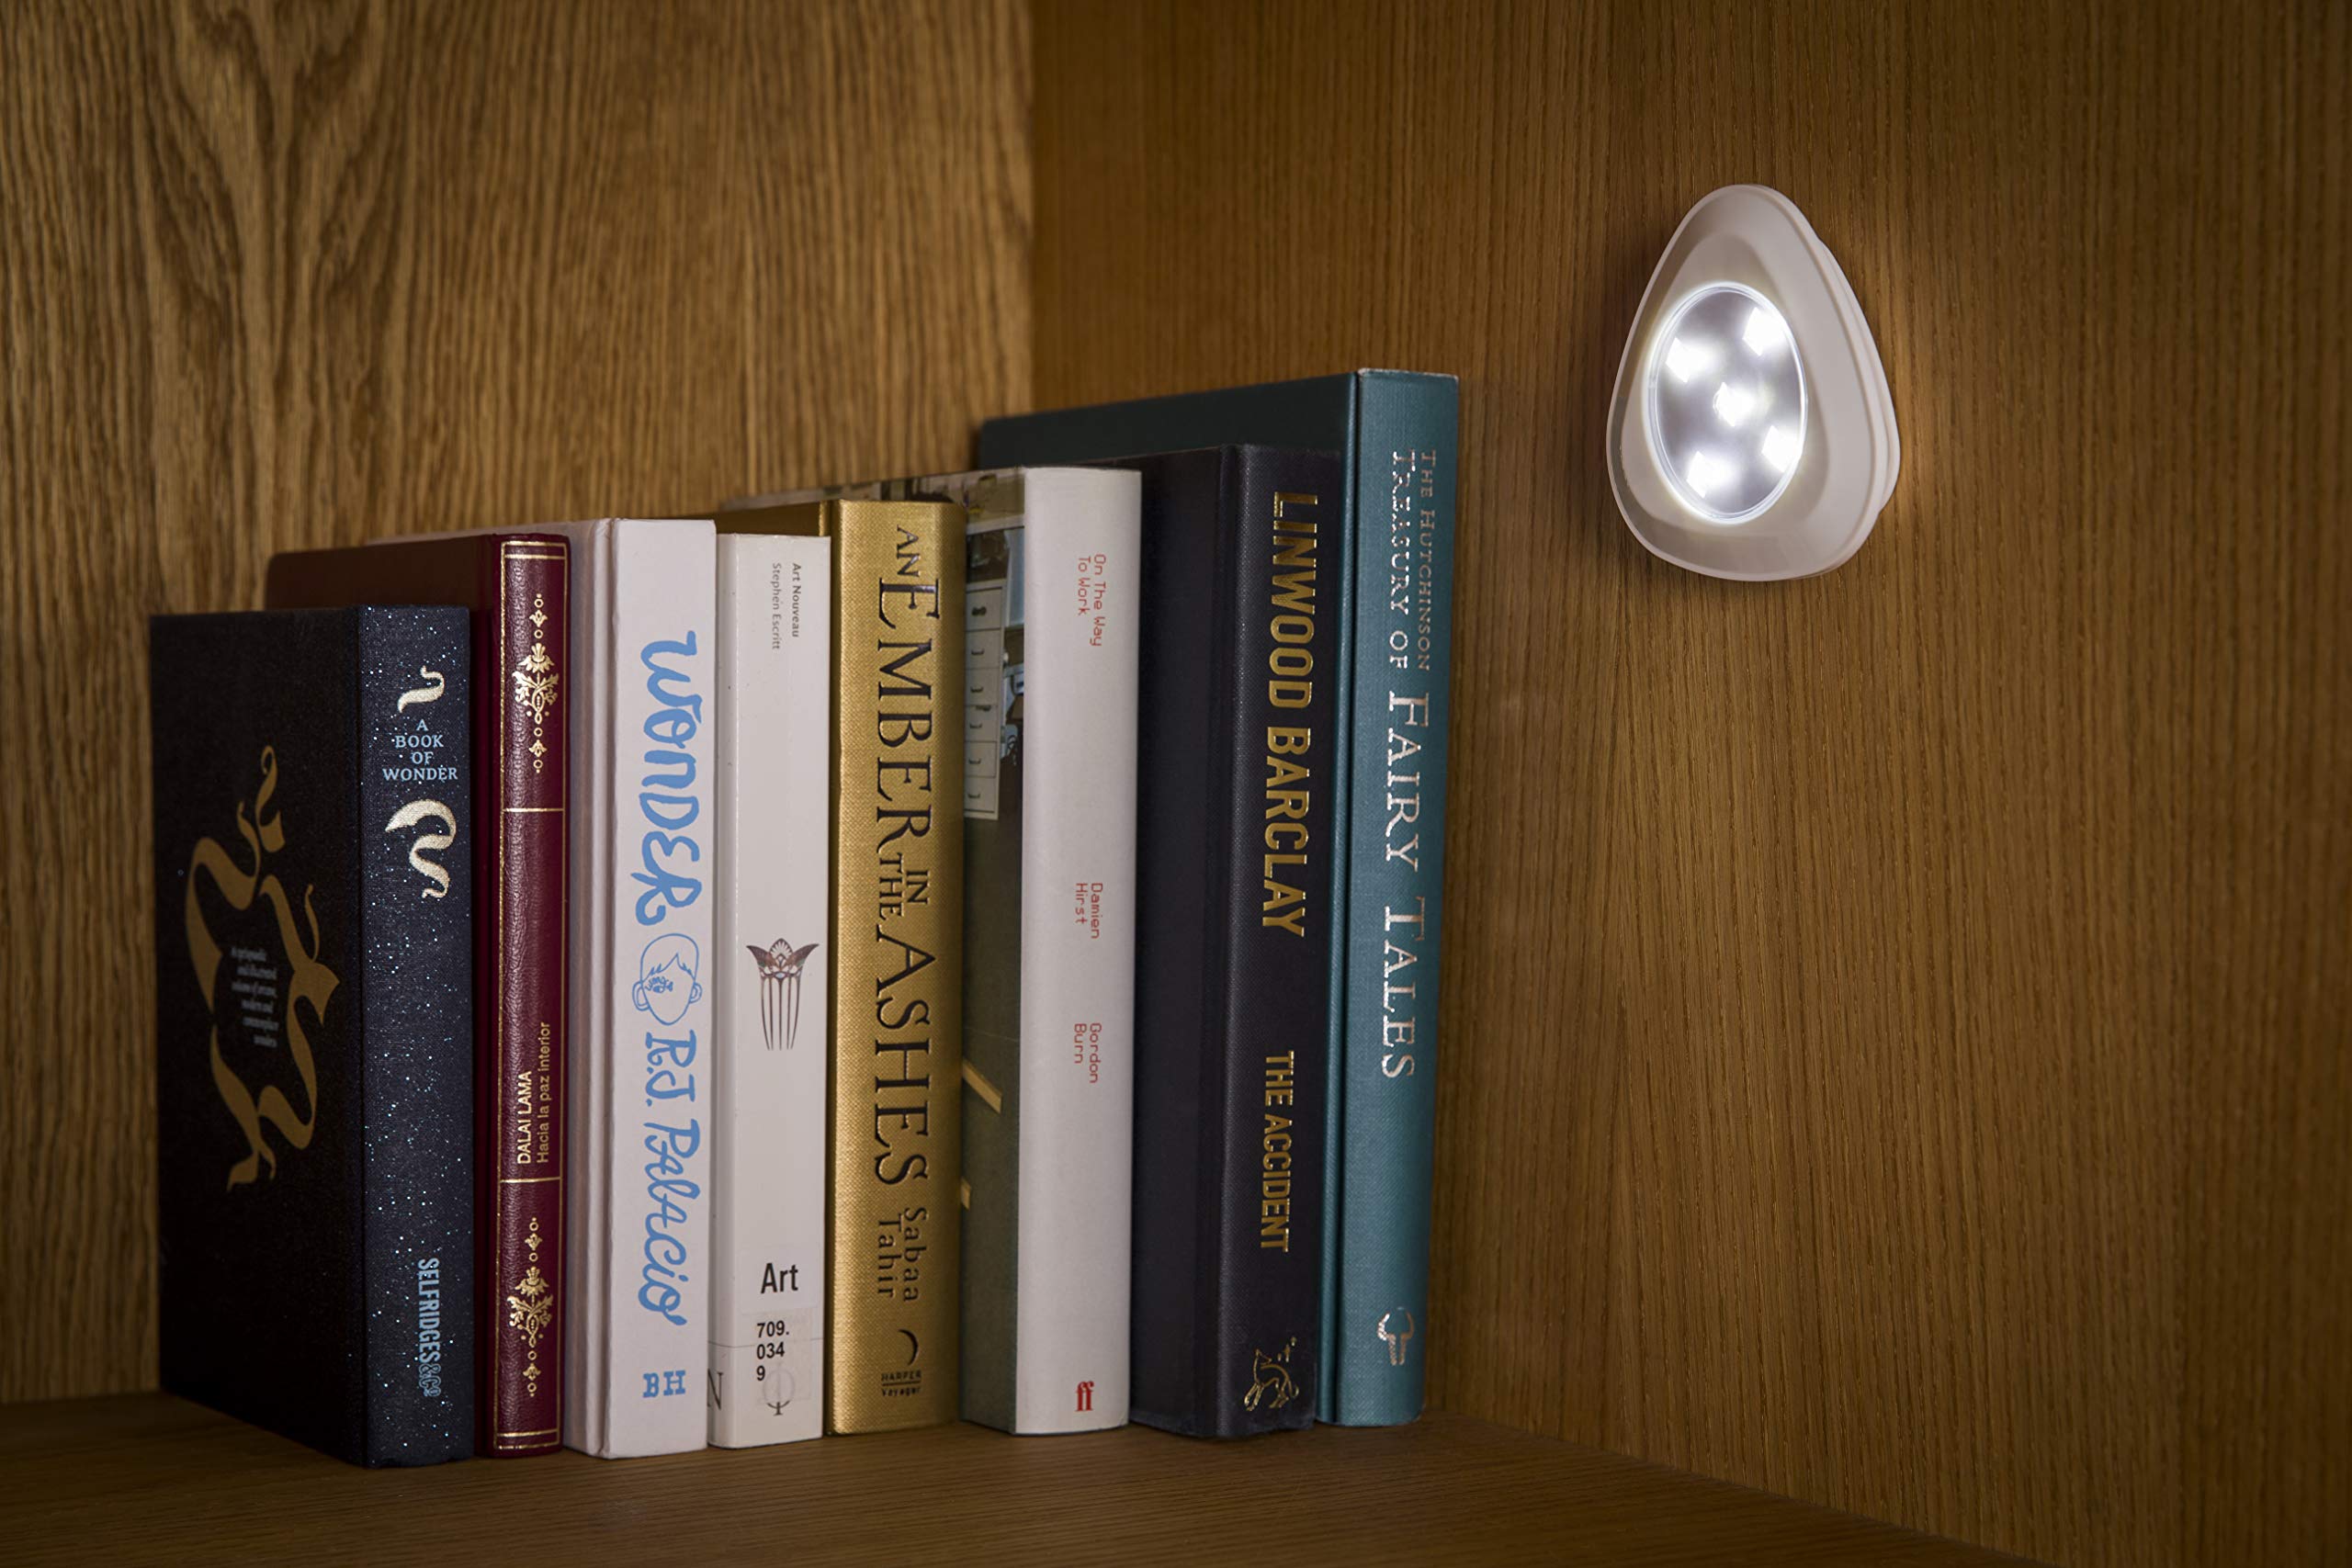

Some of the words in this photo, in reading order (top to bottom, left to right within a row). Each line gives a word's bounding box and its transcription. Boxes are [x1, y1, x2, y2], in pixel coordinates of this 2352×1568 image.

[1420, 449, 1436, 499] THE
[897, 524, 921, 578] AN
[1390, 449, 1416, 615] TREASURY
[770, 562, 782, 610] Stephen
[792, 562, 802, 581] Art
[1078, 556, 1091, 572] To
[1093, 554, 1106, 576] On
[792, 585, 802, 637] Nouveau
[1078, 577, 1091, 616] Work
[1093, 581, 1106, 611] The
[1268, 491, 1318, 709] LINWOOD
[1418, 509, 1435, 671] HUTCHINSON
[772, 614, 783, 649] Escritt
[1090, 616, 1106, 647] Way
[1389, 630, 1408, 670] OF
[416, 719, 429, 731] A
[876, 577, 940, 853] EMBER
[395, 735, 444, 748] BOOK
[411, 751, 434, 765] OF
[382, 767, 458, 782] WONDER
[1385, 690, 1430, 873] FAIRY
[1262, 727, 1312, 938] BARCLAY
[879, 852, 904, 921] THE
[906, 870, 929, 905] IN
[1075, 883, 1088, 924] Hirst
[1091, 883, 1103, 939] Damien
[1381, 896, 1425, 1078] TALES
[537, 1021, 551, 1071] interior
[875, 923, 935, 1185] ASHES
[1074, 1022, 1087, 1064] Burn
[1089, 1022, 1102, 1084] Gordon
[539, 1076, 551, 1101] paz
[644, 1028, 697, 1106] R.J.
[1264, 1050, 1295, 1108] THE
[517, 1070, 532, 1114] LAMA
[537, 1105, 550, 1118] la
[517, 1120, 532, 1165] DALAI
[537, 1122, 549, 1163] Hacia
[1260, 1112, 1293, 1253] ACCIDENT
[877, 1213, 903, 1298] Tahir
[903, 1207, 929, 1302] Sabaa
[760, 1262, 798, 1294] Art
[756, 1320, 790, 1338] 709.
[756, 1341, 786, 1360] 034
[756, 1365, 766, 1382] 9
